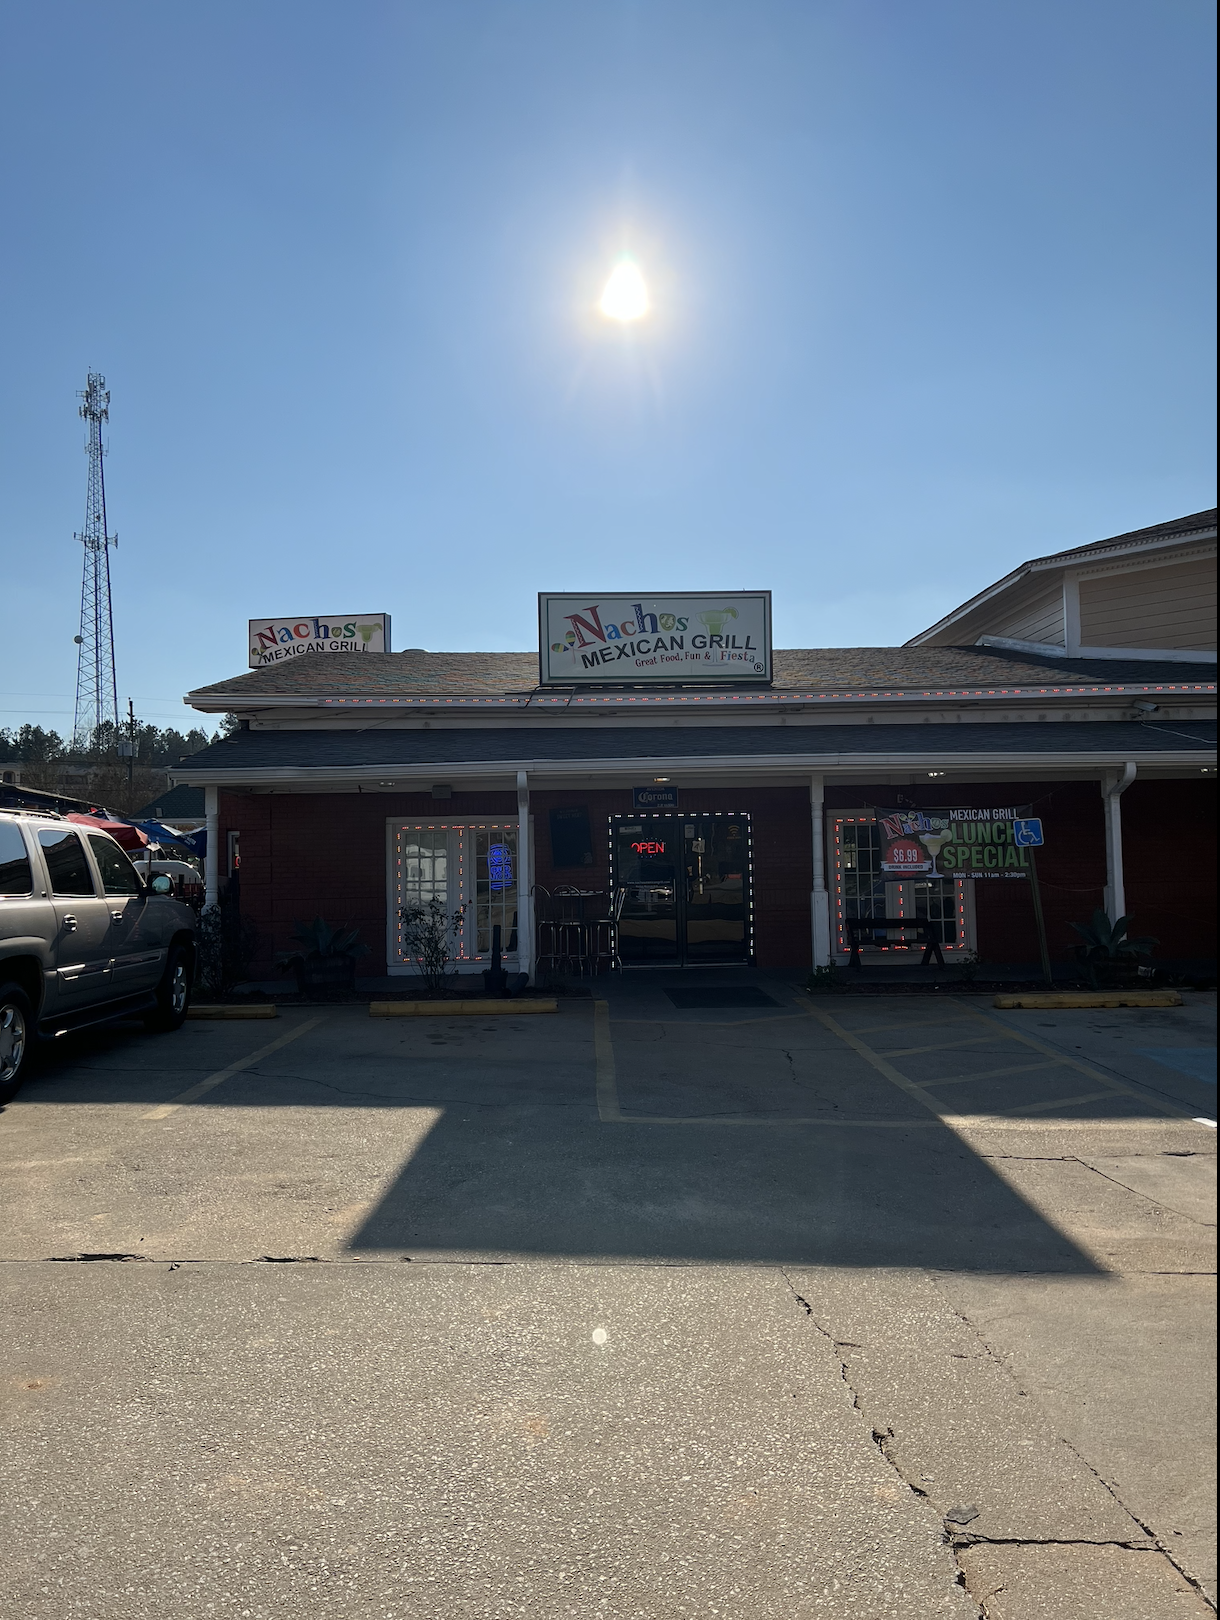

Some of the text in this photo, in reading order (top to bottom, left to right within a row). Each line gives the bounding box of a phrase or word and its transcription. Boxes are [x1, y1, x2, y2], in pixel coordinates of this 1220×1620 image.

[253, 618, 357, 650] Nachos
[563, 603, 690, 649] Nachos
[262, 641, 325, 664] MEXICAN
[581, 634, 757, 669] MEXICAN GRILL
[635, 650, 755, 668] Great Food, Fun & Fiesta
[638, 791, 673, 803] Corona
[950, 808, 1019, 821] MEXICAN GRILL
[893, 848, 918, 863] $6.99
[942, 846, 1030, 869] SPECIAL
